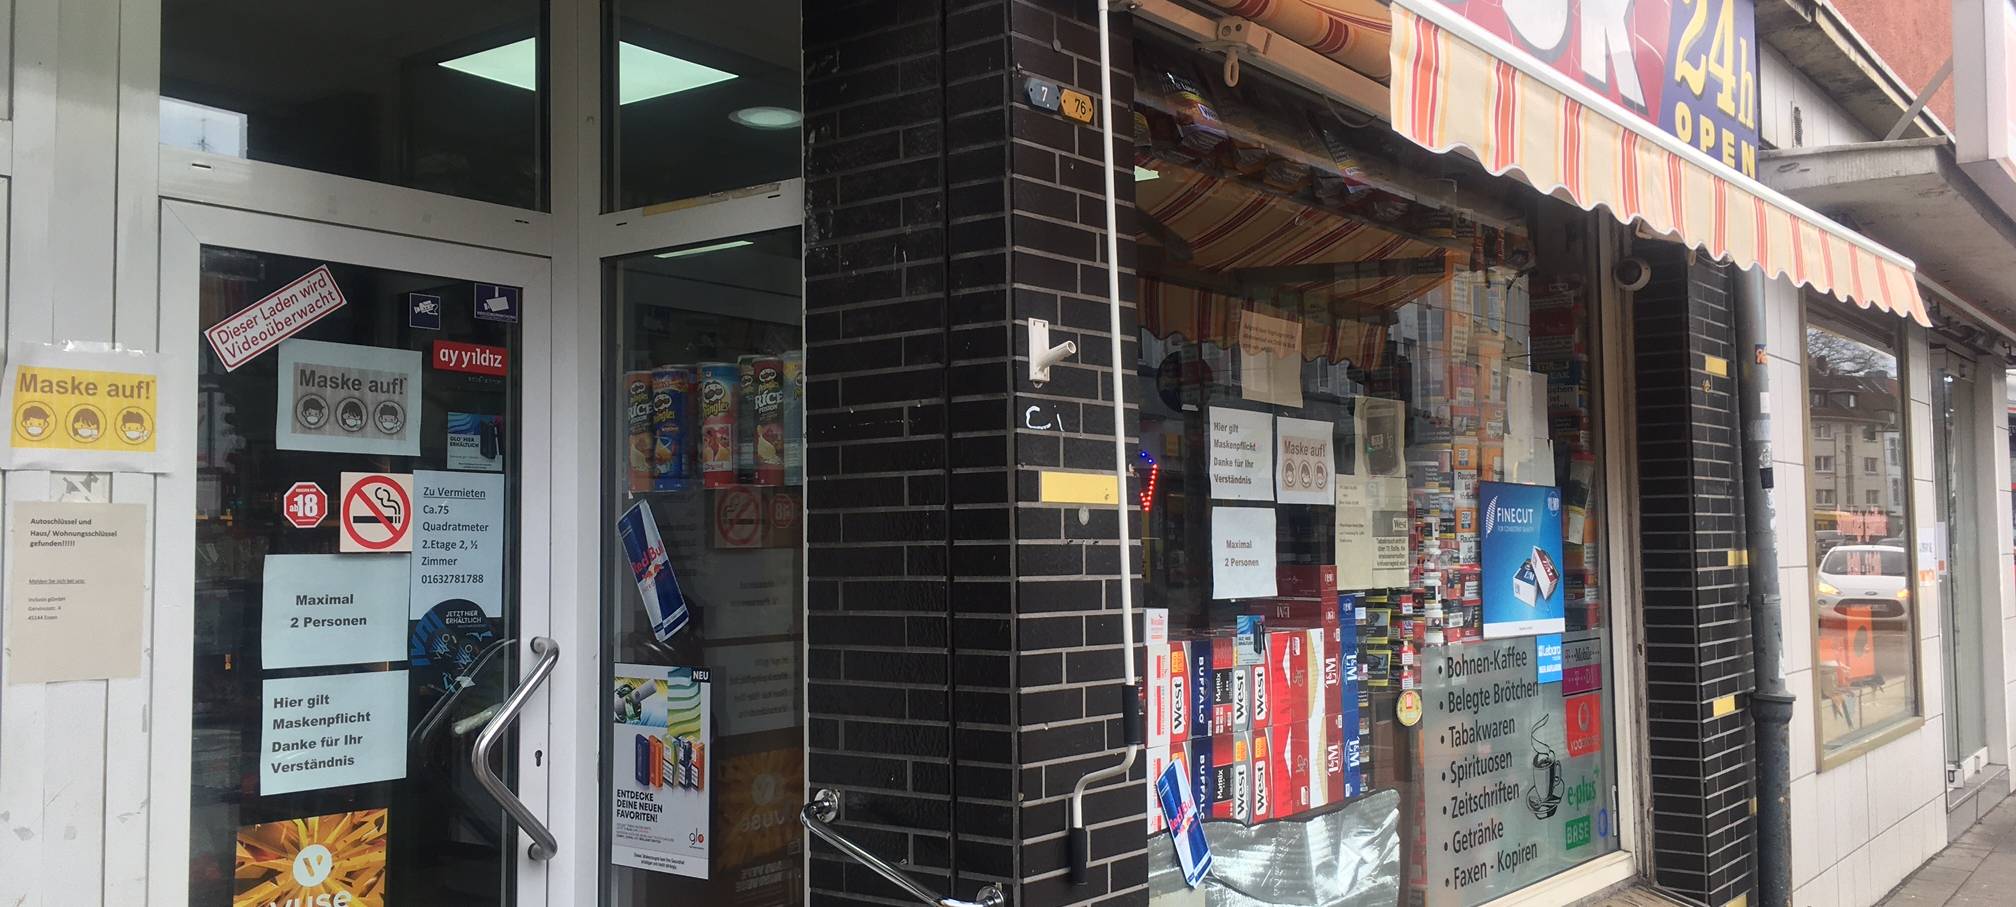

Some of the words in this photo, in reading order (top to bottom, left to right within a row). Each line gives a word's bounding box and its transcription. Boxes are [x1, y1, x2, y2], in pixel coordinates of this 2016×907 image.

[1674, 0, 1755, 131] 24h
[1041, 86, 1048, 102] 7
[1074, 98, 1087, 115] 76
[1674, 101, 1757, 180] OPEN
[217, 315, 259, 344] Dieser
[260, 292, 299, 321] Laden
[300, 273, 327, 299] wird
[225, 289, 337, 359] Videoüberwacht
[439, 348, 459, 367] ay
[19, 372, 98, 398] Maske
[107, 380, 151, 400] auf!
[300, 369, 362, 391] Maske
[368, 378, 404, 395] auf!
[1213, 421, 1228, 432] Hier
[1213, 439, 1256, 451] Maskenpflicht
[1283, 440, 1309, 456] Maske
[1310, 444, 1326, 457] auf!
[1213, 457, 1233, 467] Danke
[1234, 459, 1244, 468] für
[1244, 459, 1255, 468] Ihr
[1213, 474, 1252, 485] Verständnis
[423, 486, 437, 497] Zu
[438, 488, 486, 498] Vermieten
[294, 494, 318, 517] 18
[422, 504, 449, 515] Ca.75
[30, 518, 77, 526] Autoschlüssel
[1497, 507, 1534, 524] FINECUT
[52, 530, 118, 539] Wohnungsschlüssel
[422, 521, 488, 532] Quadratmeter
[422, 540, 457, 551] 2.Etage
[1226, 539, 1253, 549] Maximal
[421, 556, 458, 566] Zimmer
[1224, 559, 1230, 567] 2
[1231, 558, 1259, 568] Personen
[421, 575, 484, 584] 01632781788
[295, 594, 354, 606] Maximal
[290, 618, 299, 628] 2
[303, 616, 367, 628] Personen
[1447, 646, 1528, 679] Bohnen-Kaffee
[692, 670, 709, 680] NEU
[273, 697, 304, 709] Hier
[307, 694, 330, 709] gilt
[1236, 674, 1244, 720] West
[1256, 671, 1264, 716] West
[1448, 688, 1490, 718] Belegte
[1494, 678, 1539, 704] Brötchen
[1173, 682, 1182, 730] West
[272, 711, 371, 730] Maskenpflicht
[1448, 716, 1516, 748] Tabakwaren
[271, 739, 317, 752] Danke
[320, 736, 340, 747] für
[344, 734, 363, 746] Ihr
[271, 755, 355, 774] Verständnis
[1450, 751, 1513, 788] Spirituosen
[616, 789, 654, 802] ENTDECKE
[1237, 770, 1245, 815] West
[1257, 766, 1265, 811] West
[616, 799, 639, 810] DEINE
[638, 802, 663, 813] NEUEN
[1451, 781, 1520, 819] Zeitschriften
[616, 810, 658, 823] FAVORITEN!
[688, 827, 705, 845] glo
[1452, 819, 1505, 853] Getränke
[1566, 820, 1591, 844] BASE
[1454, 864, 1488, 891] Faxen
[1497, 841, 1537, 873] Kopiren
